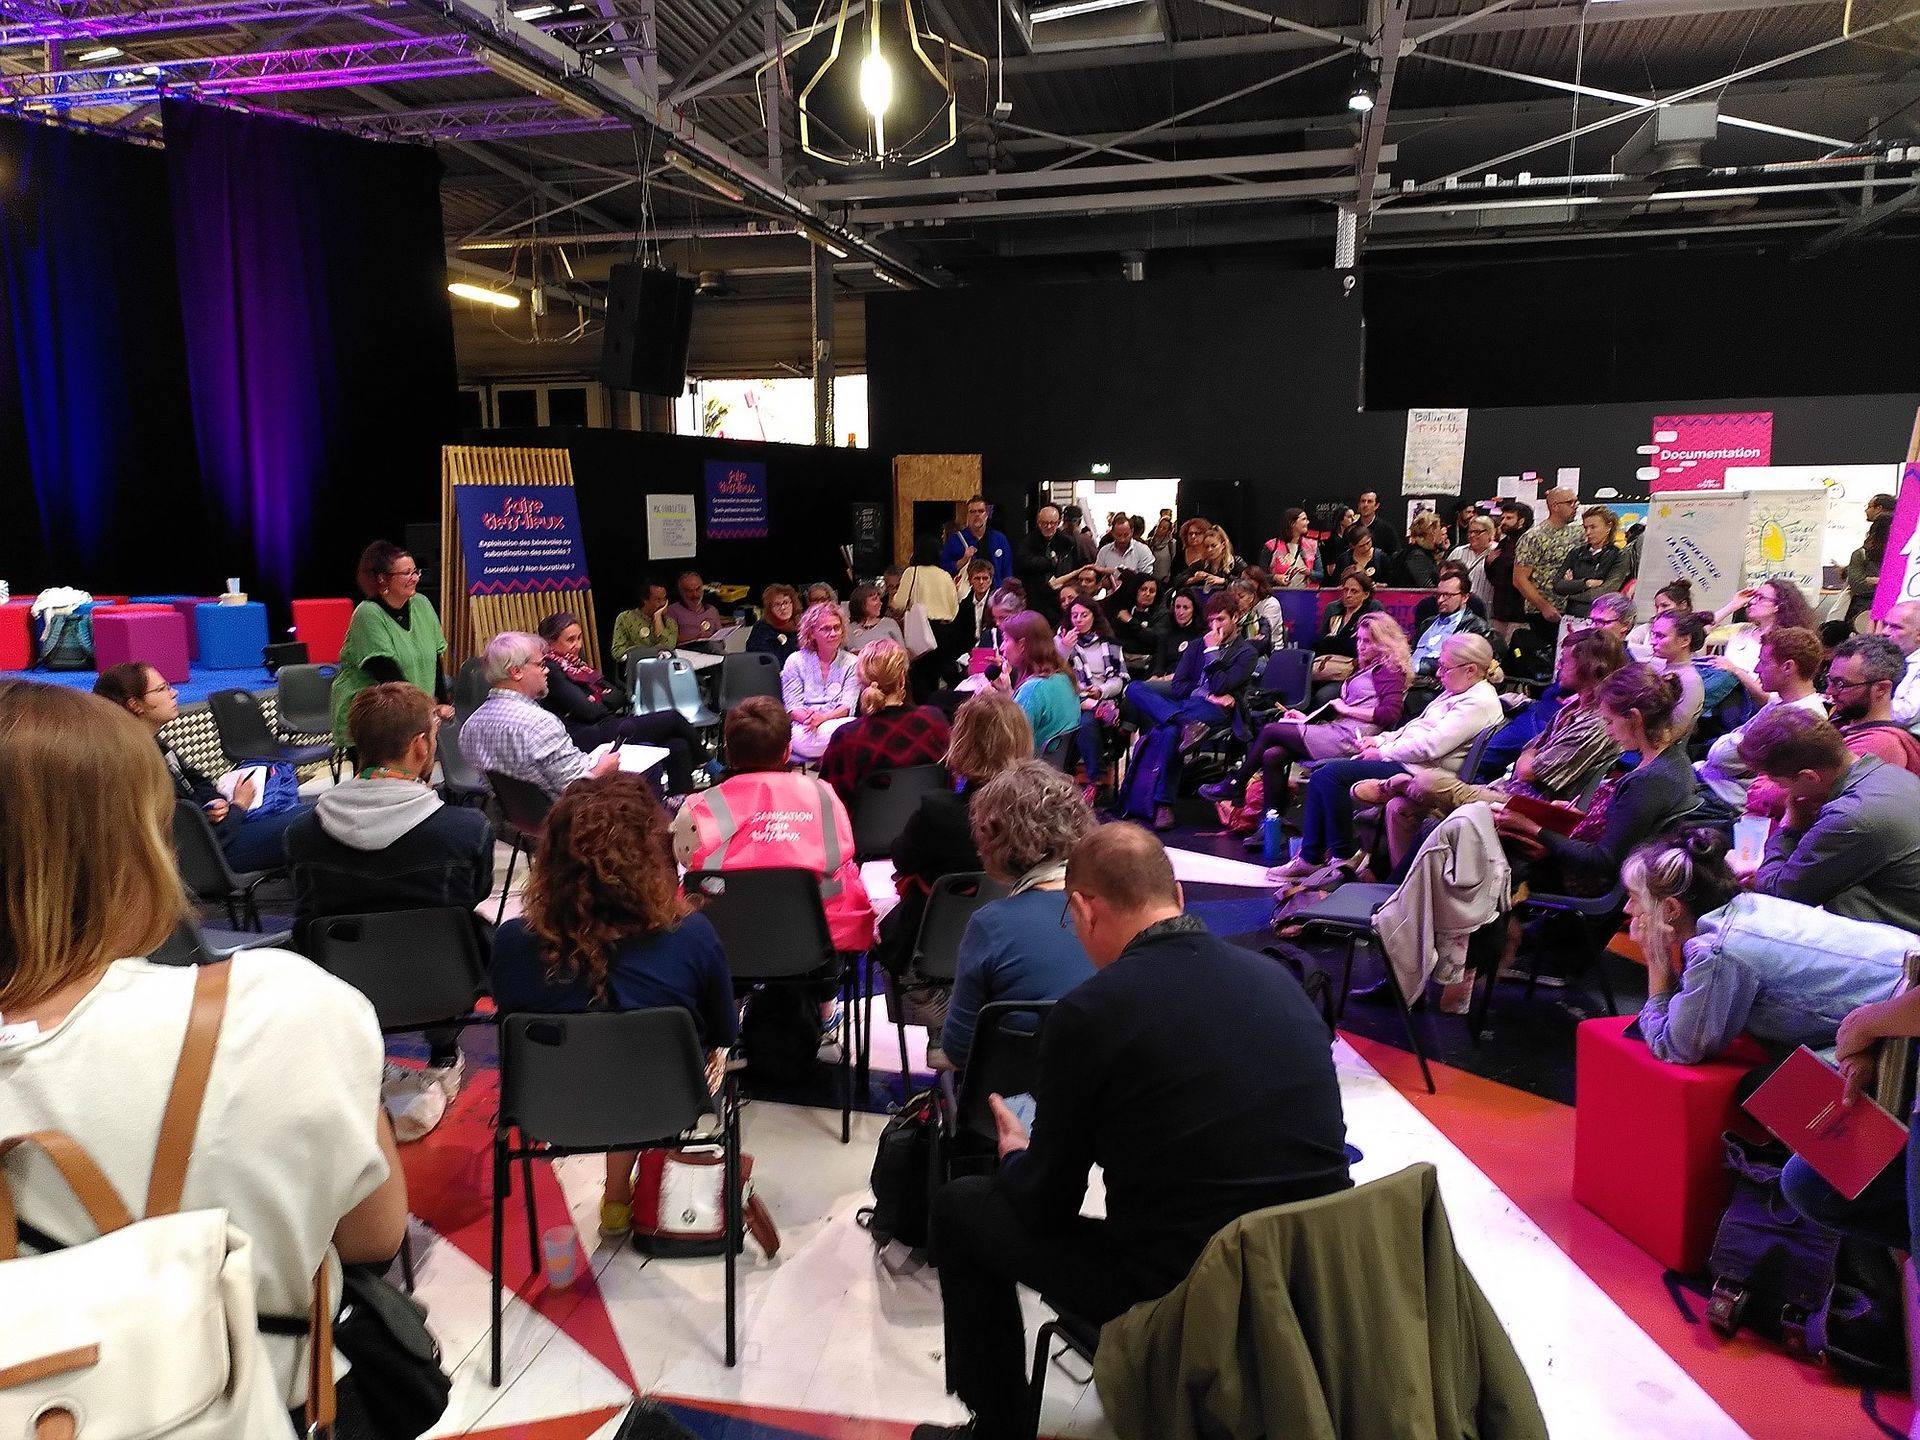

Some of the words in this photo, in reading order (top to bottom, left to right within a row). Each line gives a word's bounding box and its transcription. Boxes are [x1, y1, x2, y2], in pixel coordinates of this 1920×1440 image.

[1661, 447, 1760, 461] Documentation
[479, 539, 519, 549] Exploitation
[484, 549, 530, 558] subordination
[530, 549, 541, 557] des
